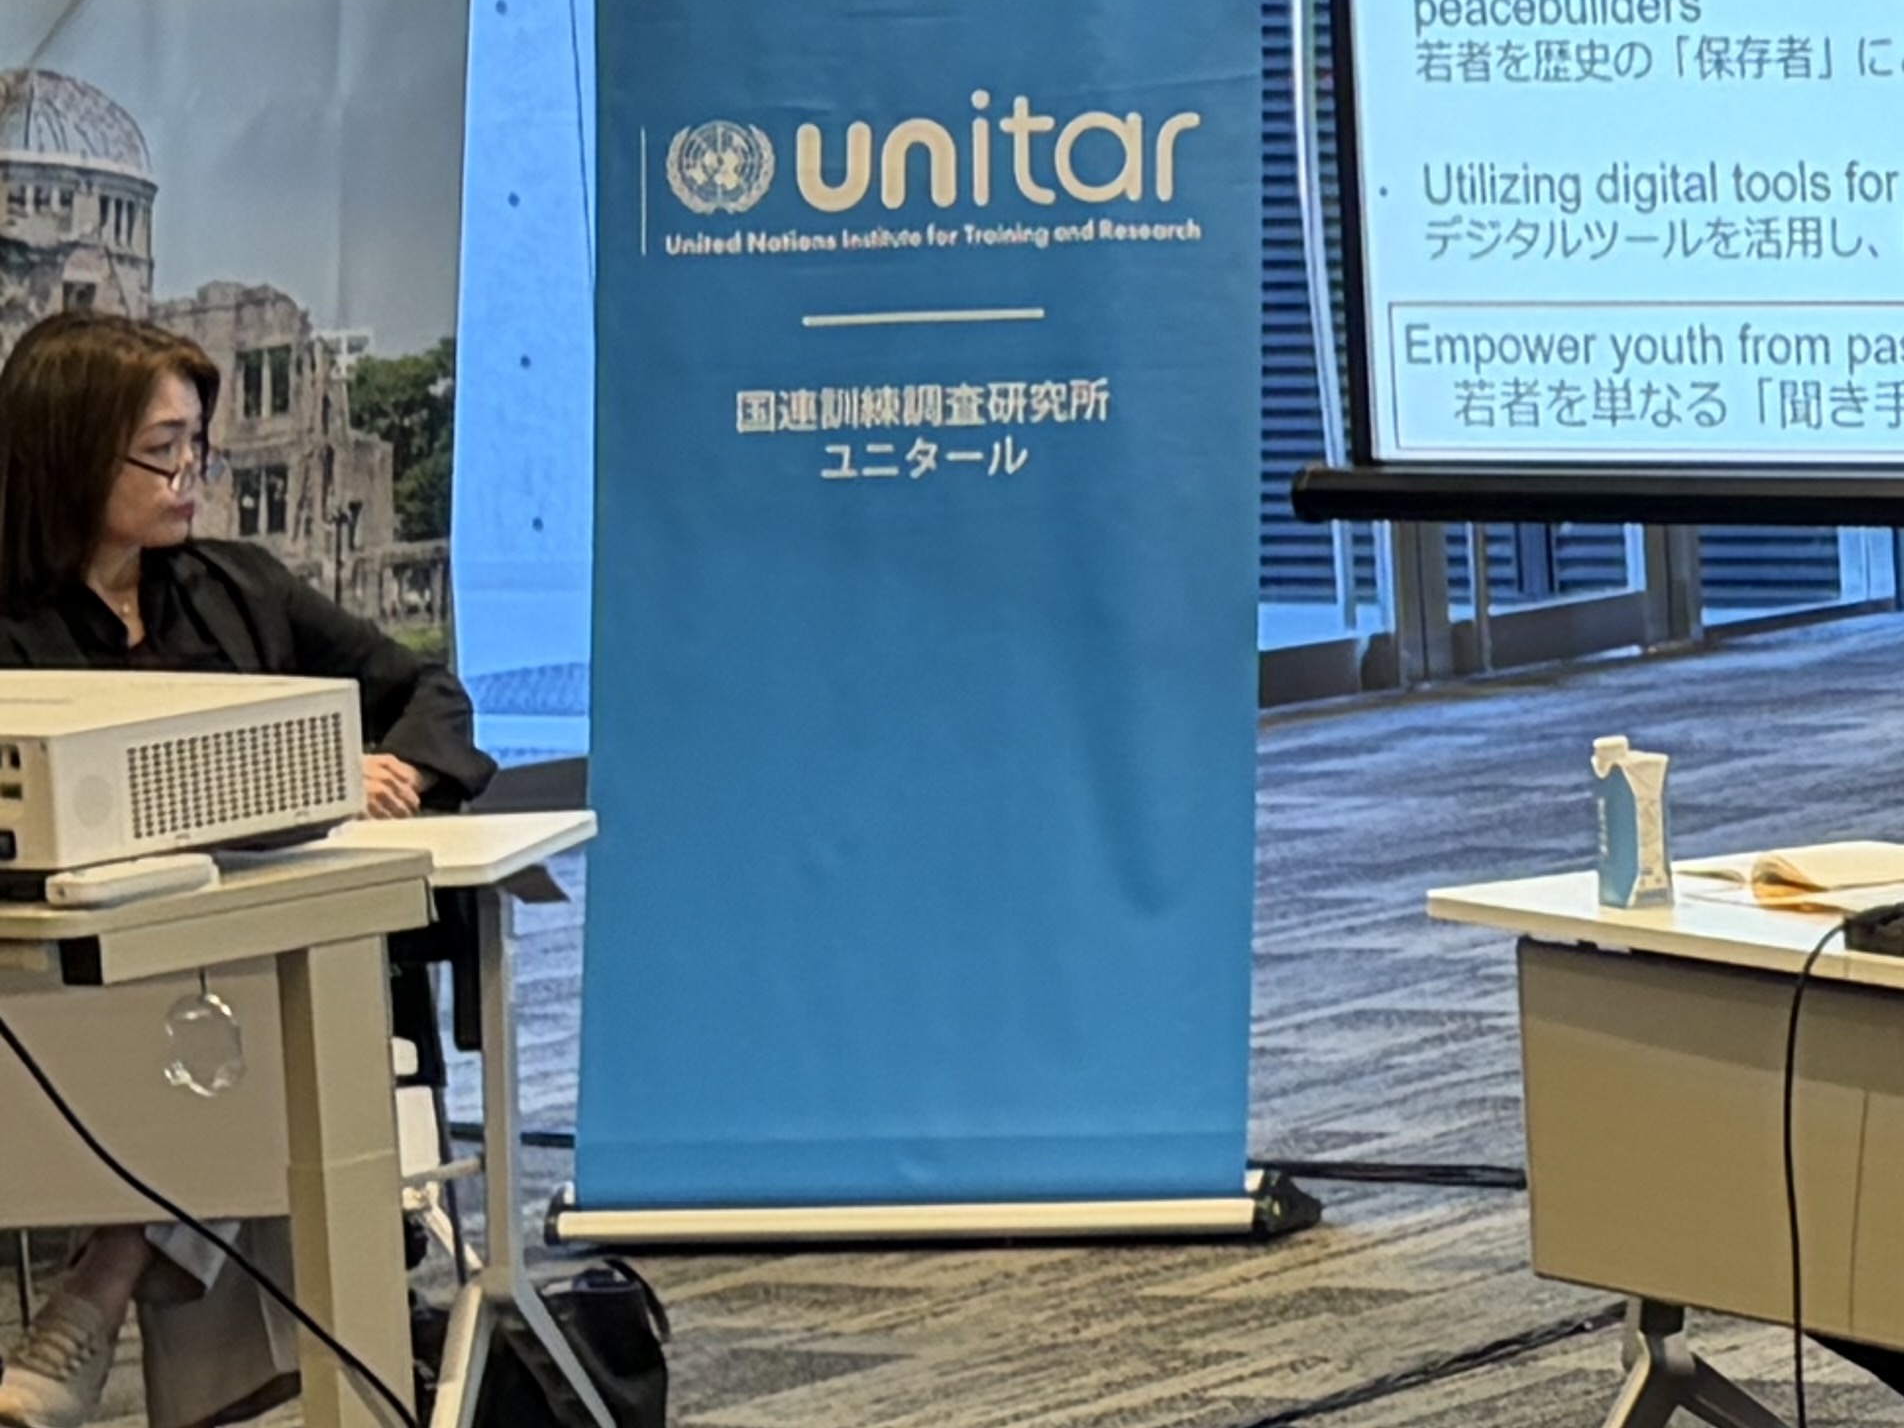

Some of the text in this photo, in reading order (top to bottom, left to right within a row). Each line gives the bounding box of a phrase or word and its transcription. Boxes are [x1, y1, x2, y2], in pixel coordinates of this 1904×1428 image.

[796, 89, 1201, 212] unitar
[1424, 162, 1581, 214] Utilizing
[1596, 160, 1717, 214] digital
[1732, 160, 1831, 203] tools
[1844, 160, 1899, 203] for
[665, 218, 1201, 256] United Nations Institute for Training and Research
[1406, 323, 1597, 374] Empower
[1610, 323, 1723, 374] youth
[1738, 322, 1830, 366] from
[736, 378, 1110, 433] 国連訓練調査研究所
[821, 436, 1029, 478] ユニタール
